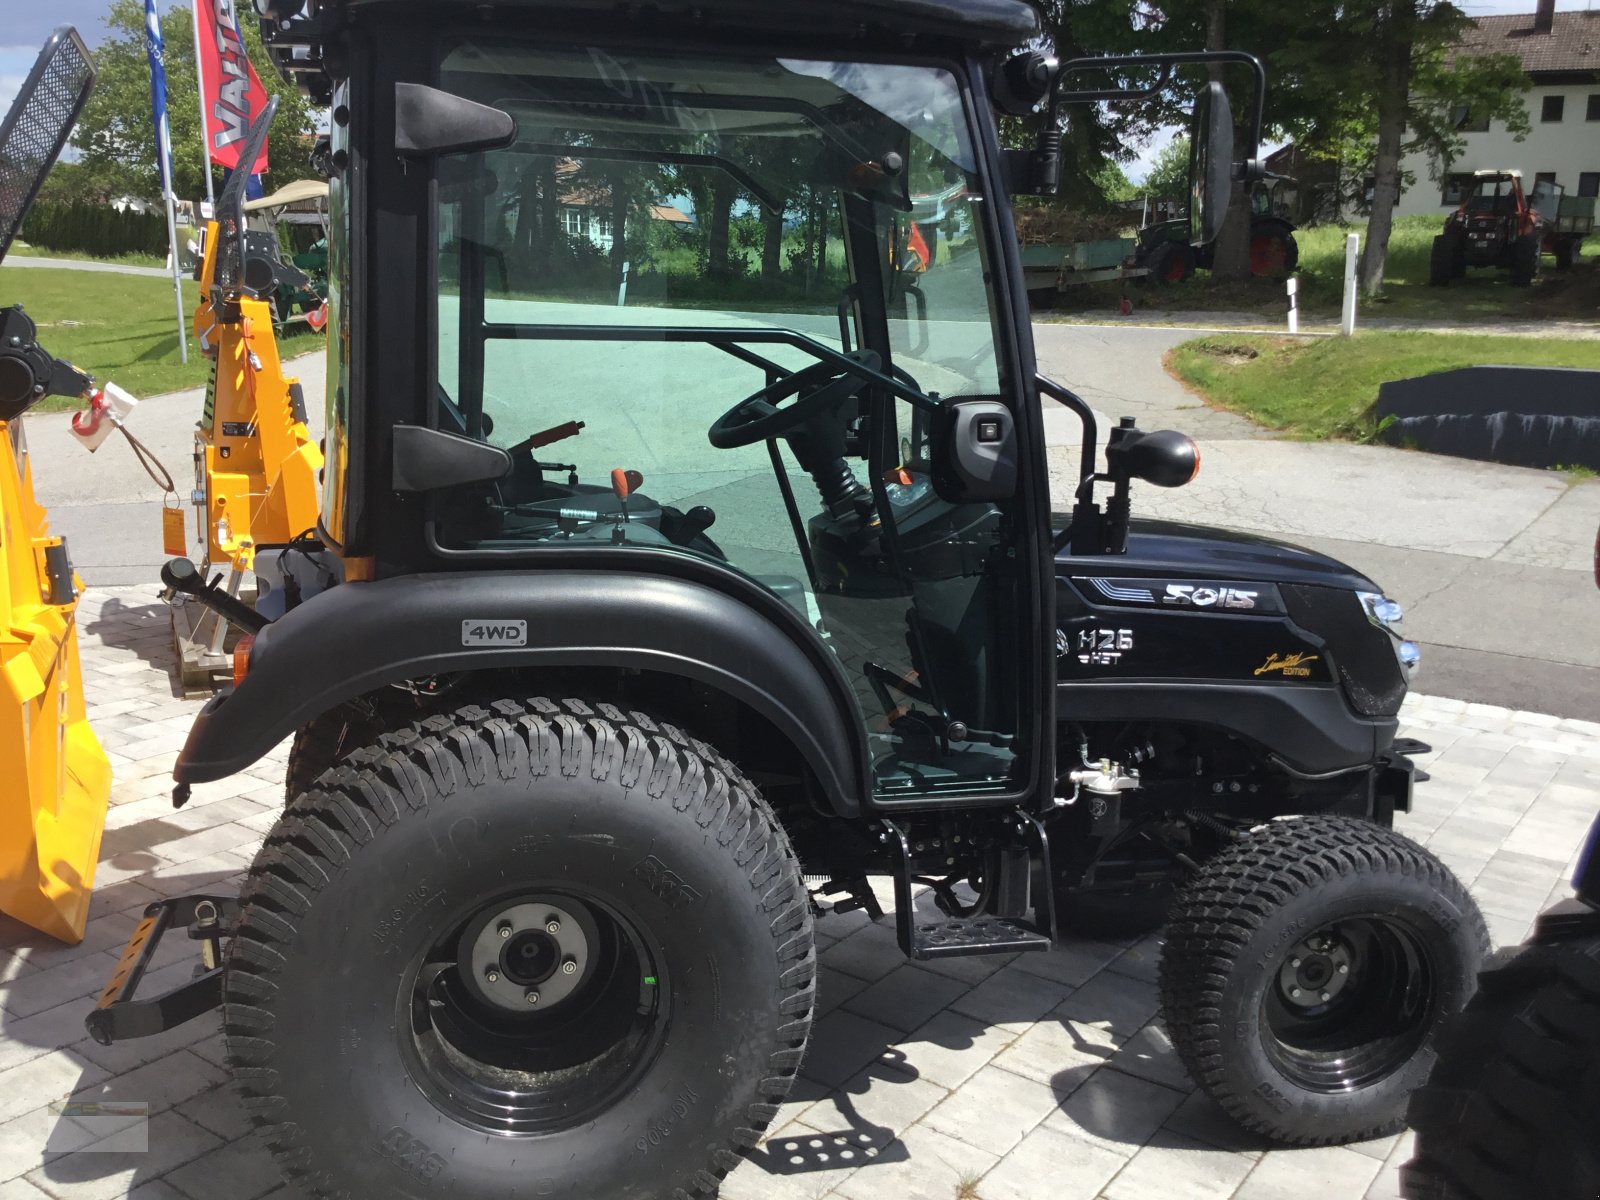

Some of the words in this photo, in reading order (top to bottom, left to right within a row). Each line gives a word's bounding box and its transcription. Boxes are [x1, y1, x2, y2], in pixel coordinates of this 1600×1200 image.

[470, 625, 521, 640] 4WD
[1254, 651, 1318, 676] Limited
[1282, 666, 1310, 676] EDITION
